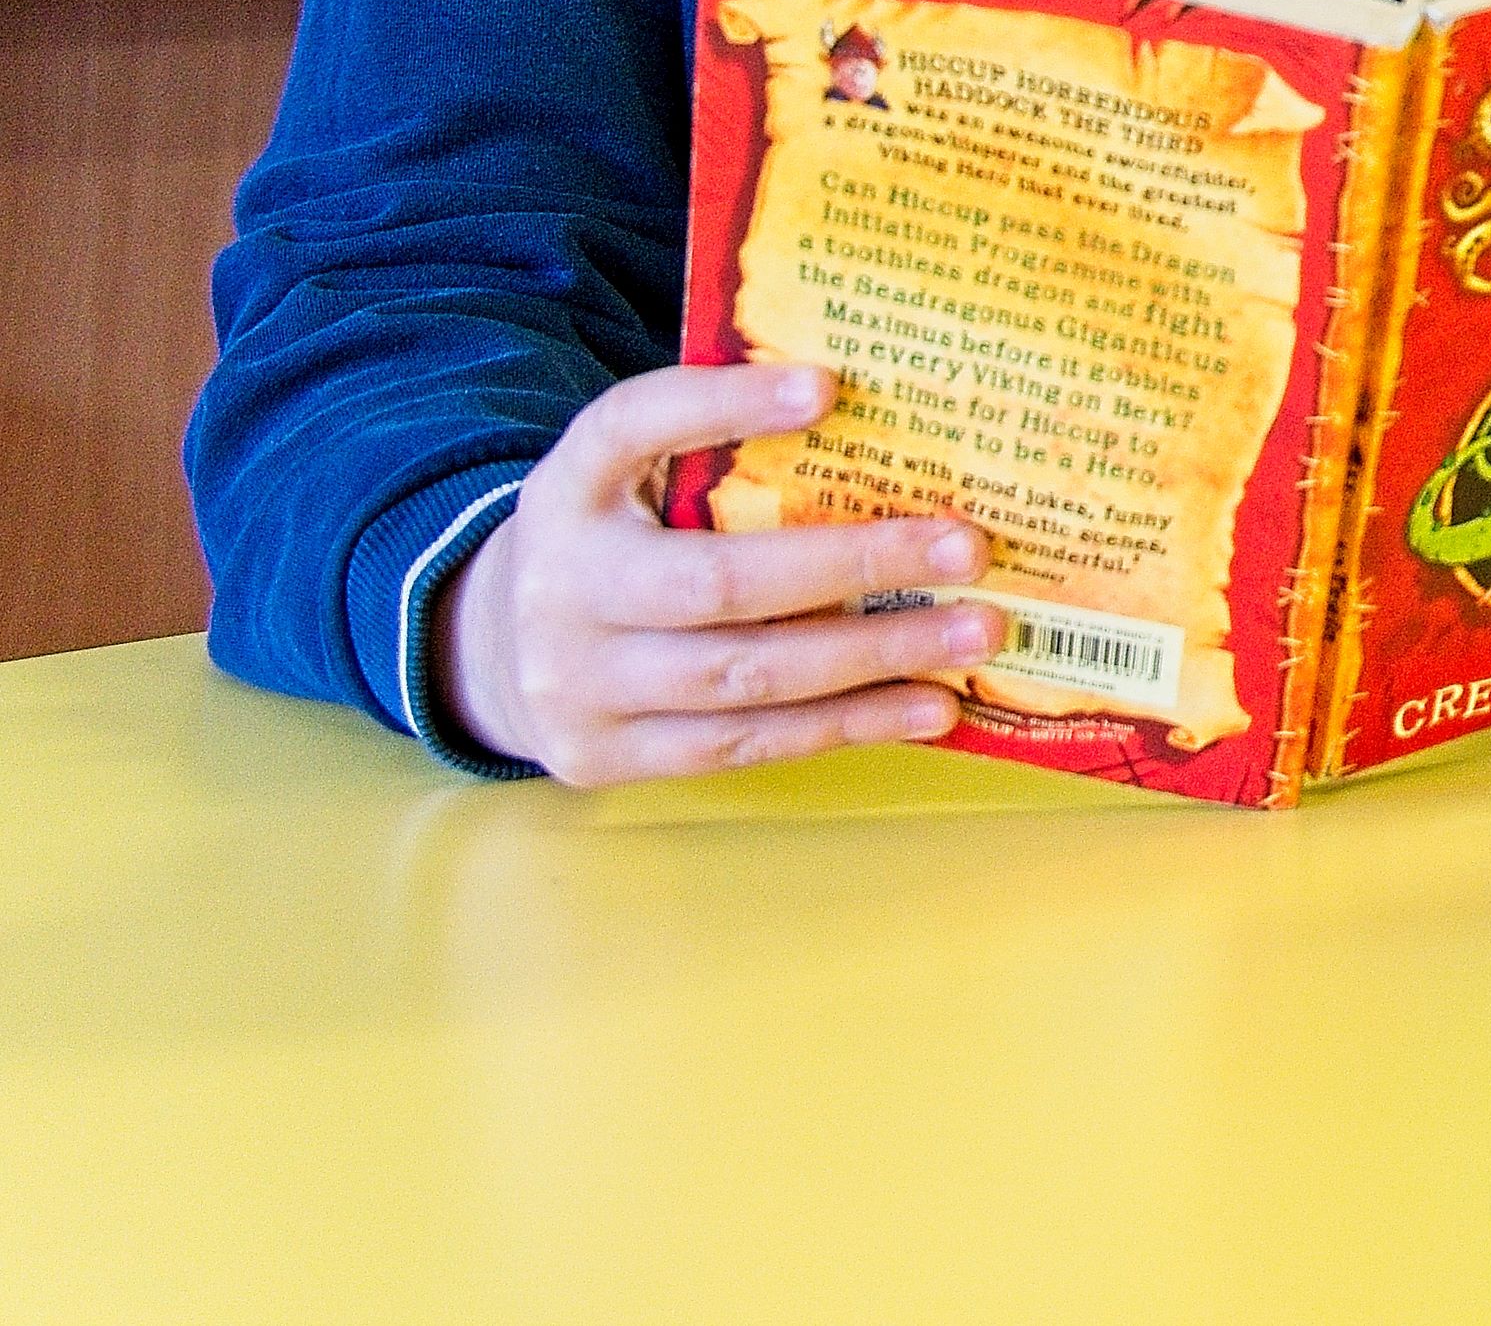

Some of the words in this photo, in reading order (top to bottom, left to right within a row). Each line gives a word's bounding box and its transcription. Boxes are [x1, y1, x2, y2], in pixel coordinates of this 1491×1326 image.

[896, 45, 1007, 88] HICCUP
[1012, 70, 1213, 135] HORRENDOUS
[911, 73, 1049, 122] HADDOCK
[1057, 107, 1110, 136] THE
[1119, 121, 1204, 158] THIRD
[819, 169, 880, 201] Can
[886, 183, 992, 228] Hiccup
[997, 213, 1067, 247] pass
[1075, 229, 1124, 256] the
[1129, 241, 1238, 285] Dragon
[821, 201, 960, 251] Initiation
[967, 235, 1141, 295] Programme
[1148, 277, 1212, 308] with
[795, 262, 844, 290] the
[851, 273, 1048, 338] Seadragonus
[1053, 319, 1230, 378] Giganticus
[798, 233, 815, 250] a
[822, 234, 962, 283] toothless
[972, 264, 1077, 309] dragon
[1083, 292, 1134, 320] and
[1139, 302, 1227, 345] fight
[822, 299, 956, 348] Maximus
[959, 330, 1053, 370] before
[1059, 355, 1080, 378] it
[1087, 359, 1202, 404] gobbles
[825, 331, 859, 357] up
[867, 340, 964, 382] every
[969, 363, 1062, 406] Viking
[1066, 388, 1103, 413] on
[1111, 392, 1196, 433] Berk?
[833, 396, 899, 428] earn
[907, 411, 966, 443] how
[972, 430, 1003, 455] to
[1011, 438, 1053, 465] be
[1058, 453, 1074, 470] a
[1083, 454, 1167, 491] Hero.
[891, 379, 959, 414] time
[968, 395, 1009, 425] for
[1017, 408, 1121, 452] Hiccup
[1126, 434, 1160, 459] to
[793, 456, 906, 500] drawings
[911, 482, 955, 510] and
[961, 497, 1070, 538] dramatic
[804, 428, 894, 468] Bulging
[901, 453, 954, 483] with
[958, 469, 1020, 501] good
[1024, 485, 1097, 521] jokes,
[1102, 500, 1174, 535] funny
